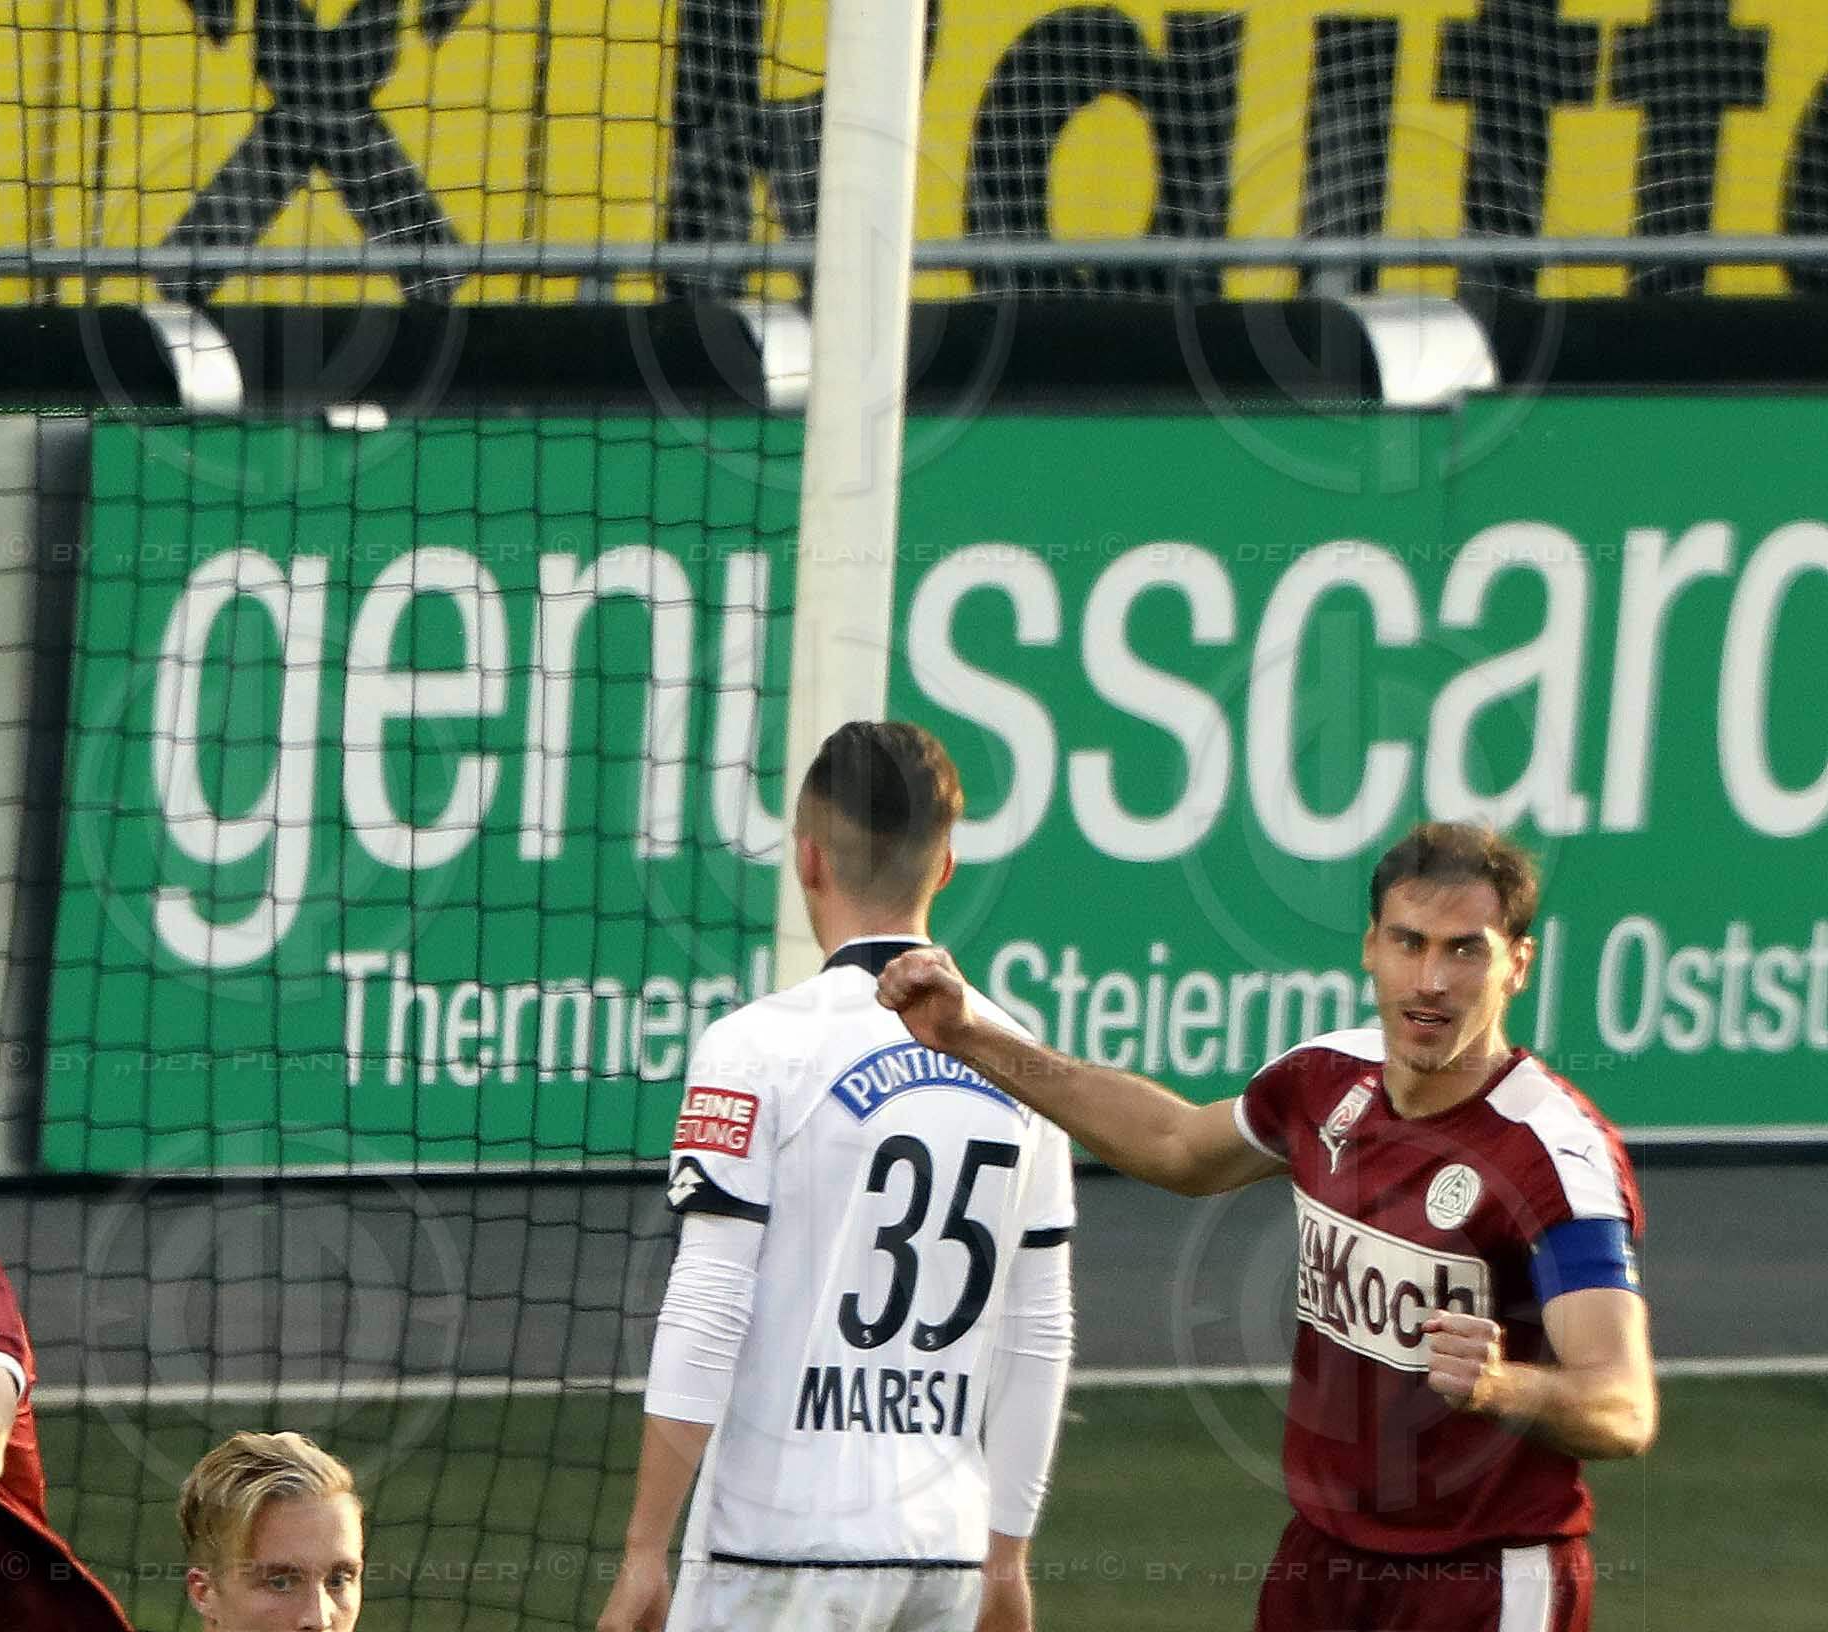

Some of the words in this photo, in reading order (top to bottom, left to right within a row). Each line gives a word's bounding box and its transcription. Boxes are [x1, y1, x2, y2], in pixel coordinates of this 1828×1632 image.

[988, 940, 1380, 1078] Steierm
[681, 1093, 754, 1123] LEINE
[838, 1133, 1020, 1352] 35
[794, 1366, 970, 1437] MARESI
